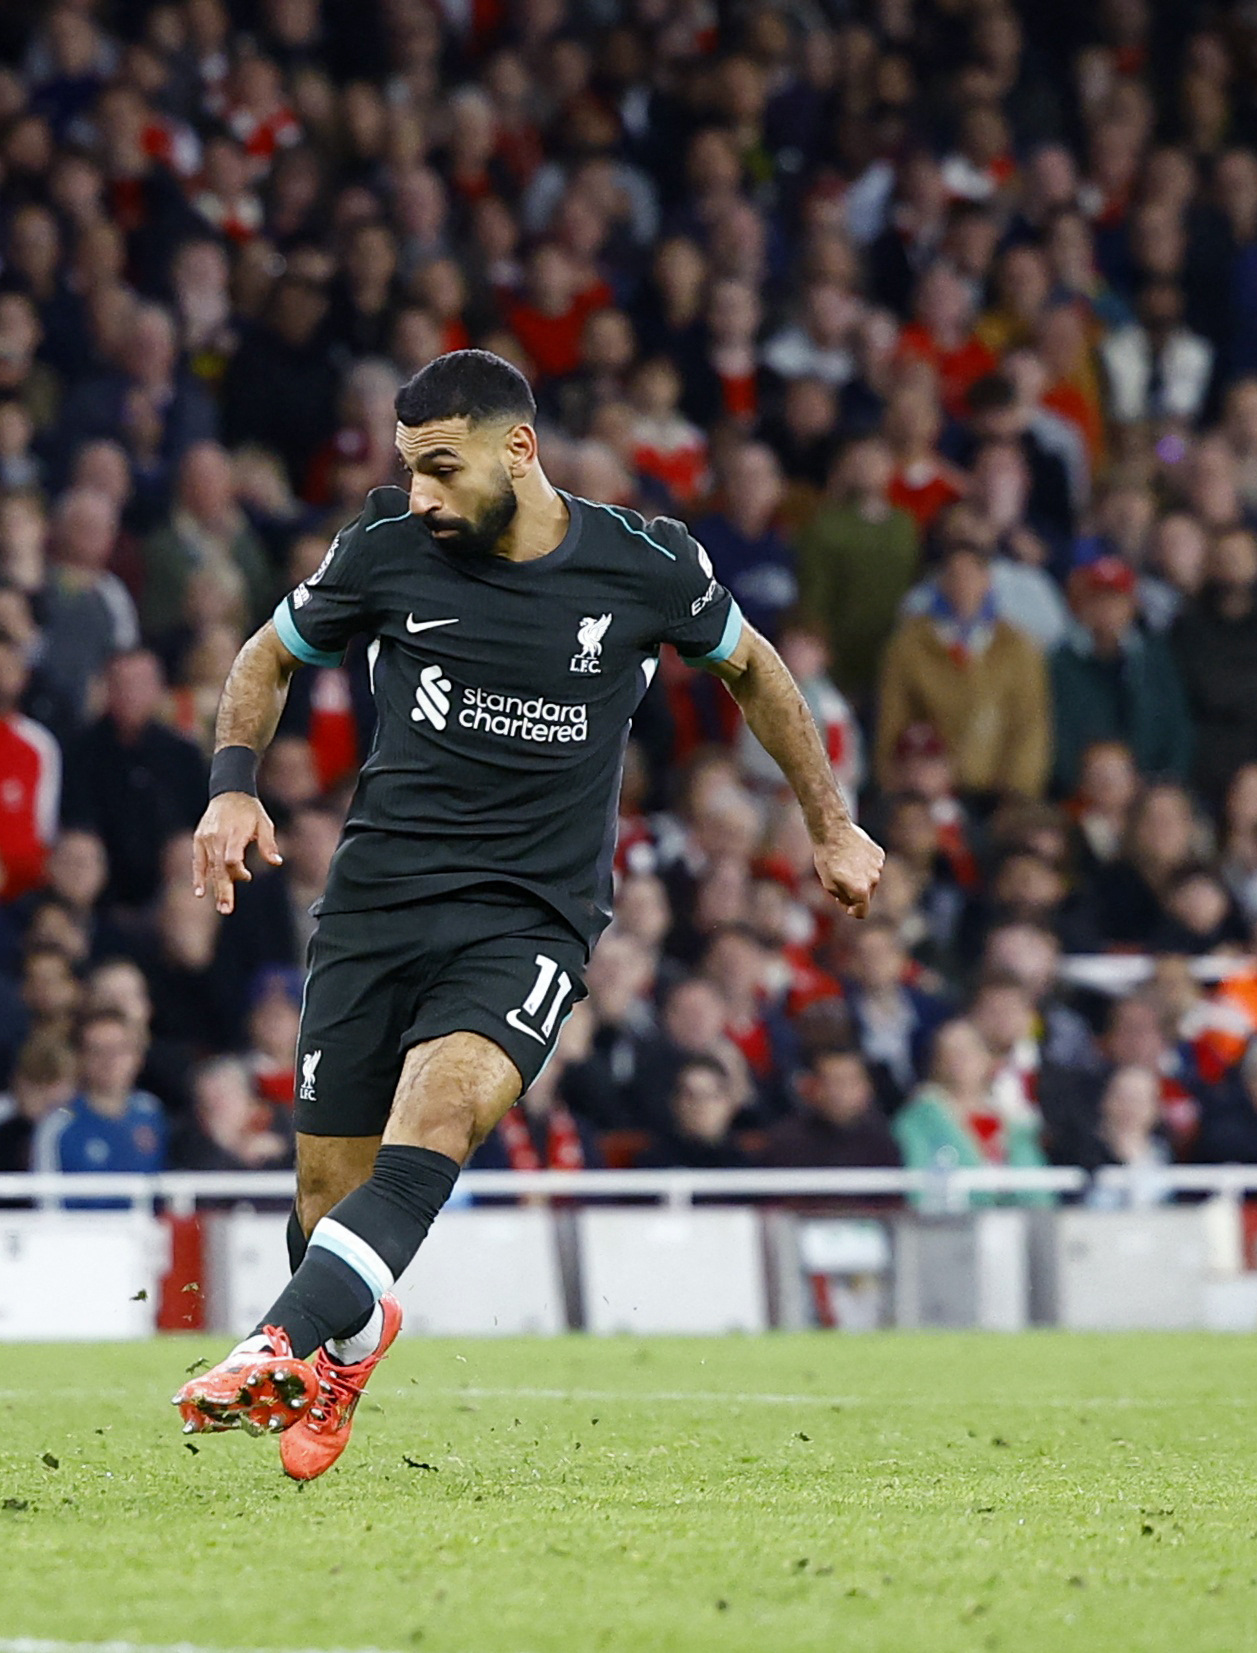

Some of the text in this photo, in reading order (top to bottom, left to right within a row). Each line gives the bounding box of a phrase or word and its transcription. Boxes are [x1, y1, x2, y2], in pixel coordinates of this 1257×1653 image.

[462, 687, 586, 723] standard
[458, 707, 587, 742] chartered
[522, 953, 573, 1039] 11
